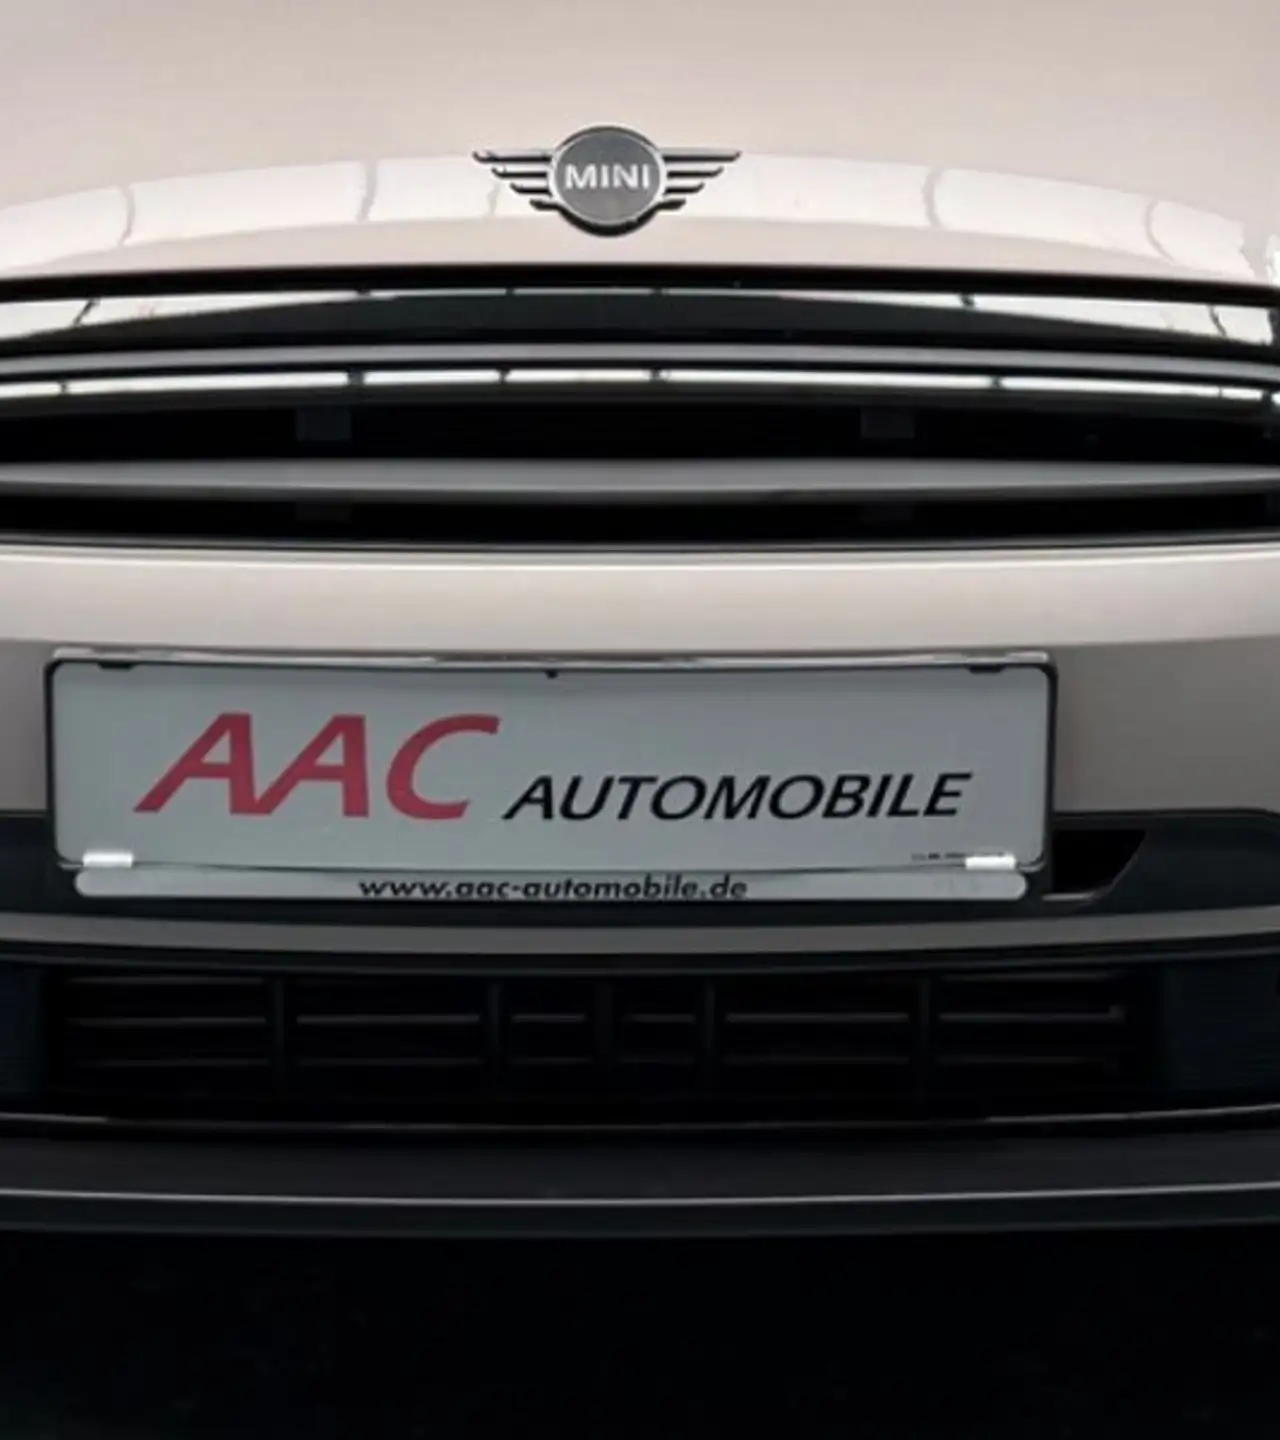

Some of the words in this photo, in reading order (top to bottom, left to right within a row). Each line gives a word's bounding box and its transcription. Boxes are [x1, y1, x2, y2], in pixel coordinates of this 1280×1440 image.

[564, 163, 650, 190] MINI
[132, 711, 501, 820] AAC
[502, 772, 973, 821] AUTOMOBILE
[358, 873, 749, 900] www.aac-automobile.de
